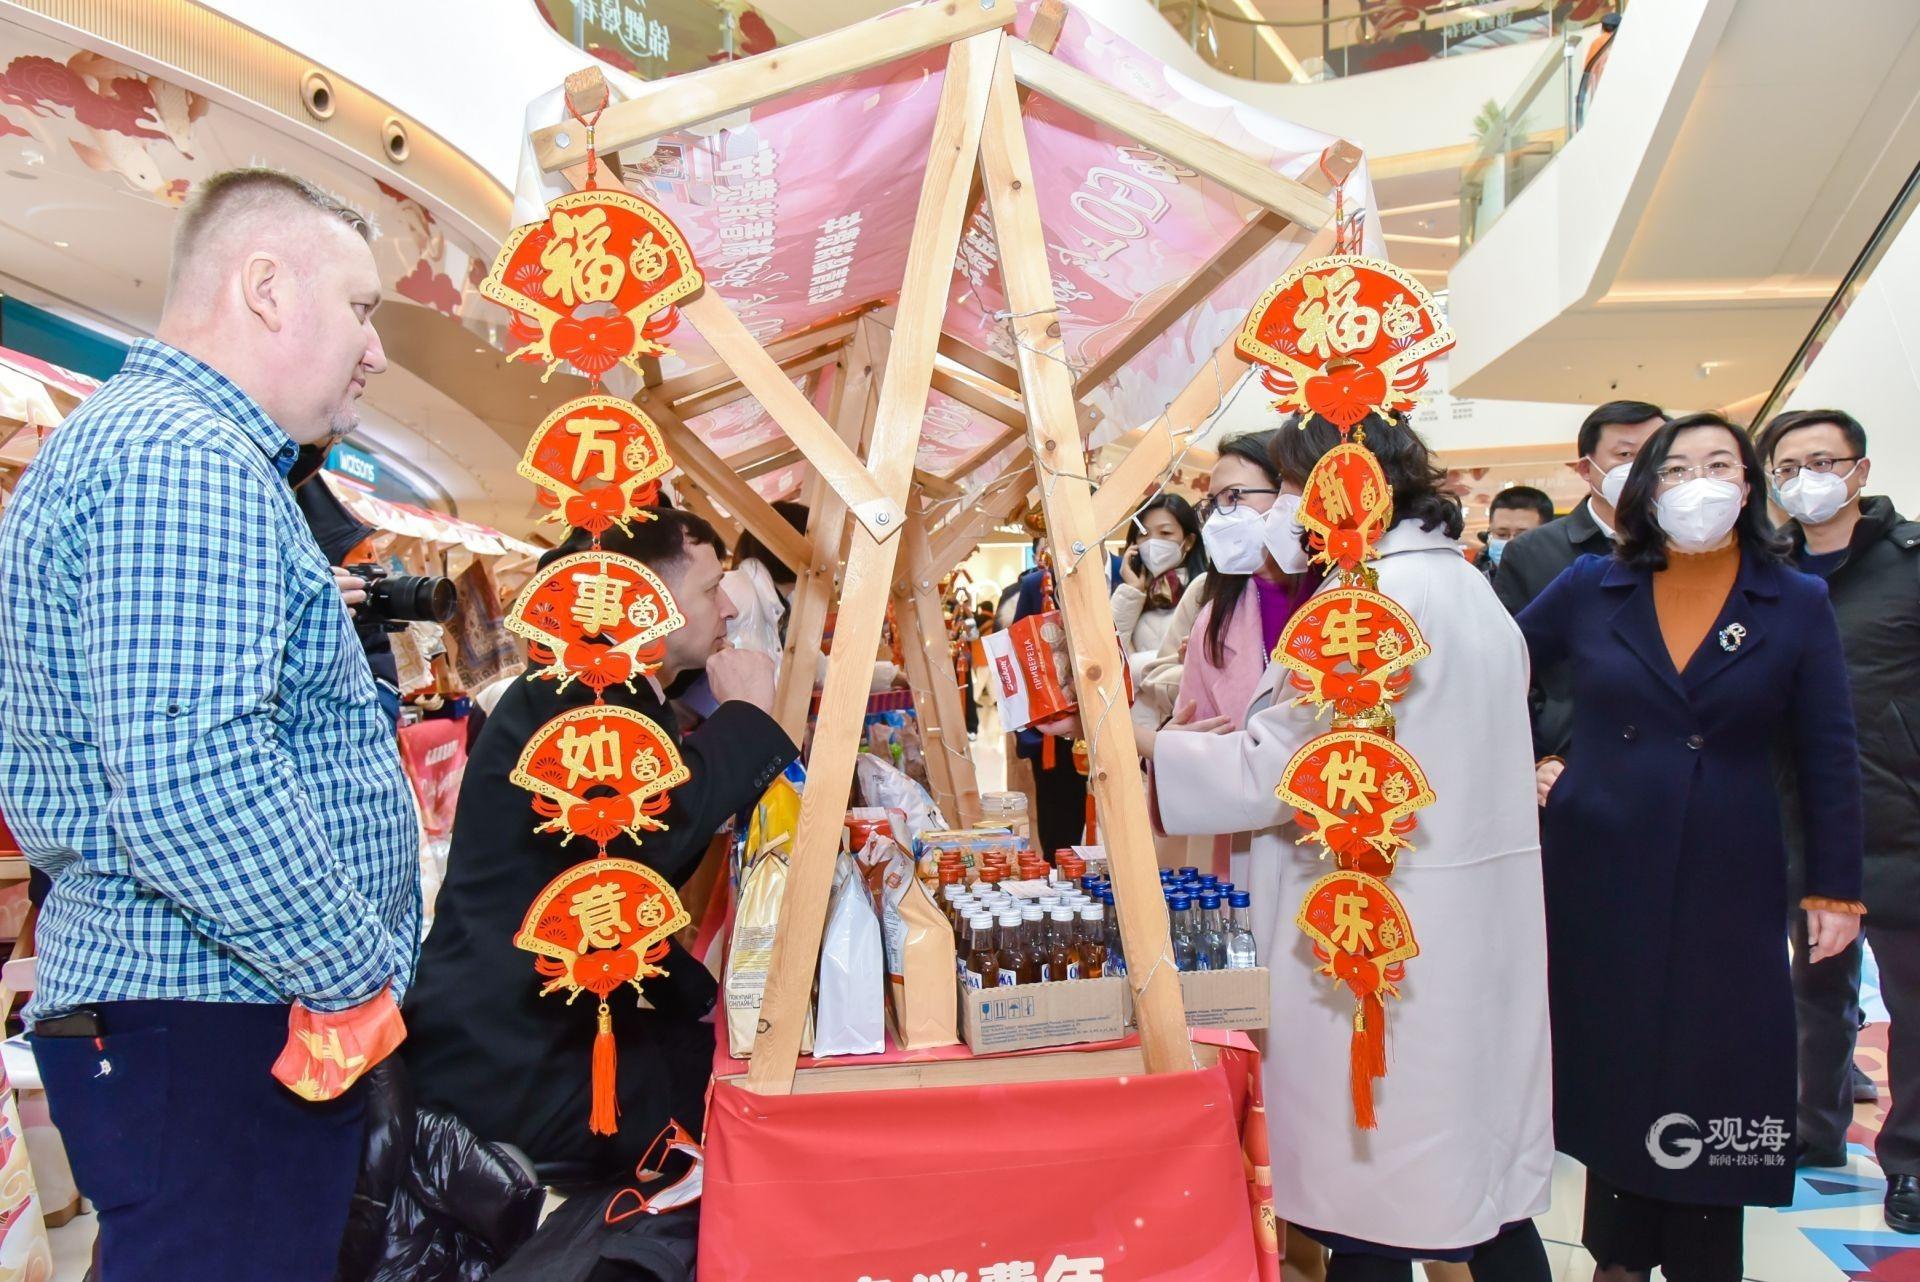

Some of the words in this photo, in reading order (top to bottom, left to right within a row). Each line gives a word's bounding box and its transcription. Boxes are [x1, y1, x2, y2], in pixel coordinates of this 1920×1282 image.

[540, 207, 626, 307] 福
[1293, 265, 1381, 358] 福
[339, 450, 375, 482] watsons
[1025, 639, 1042, 690] ПРИВЕРЕДА
[728, 993, 753, 1001] ПОКУПАЙ
[728, 999, 753, 1007] ОНЛАЙН
